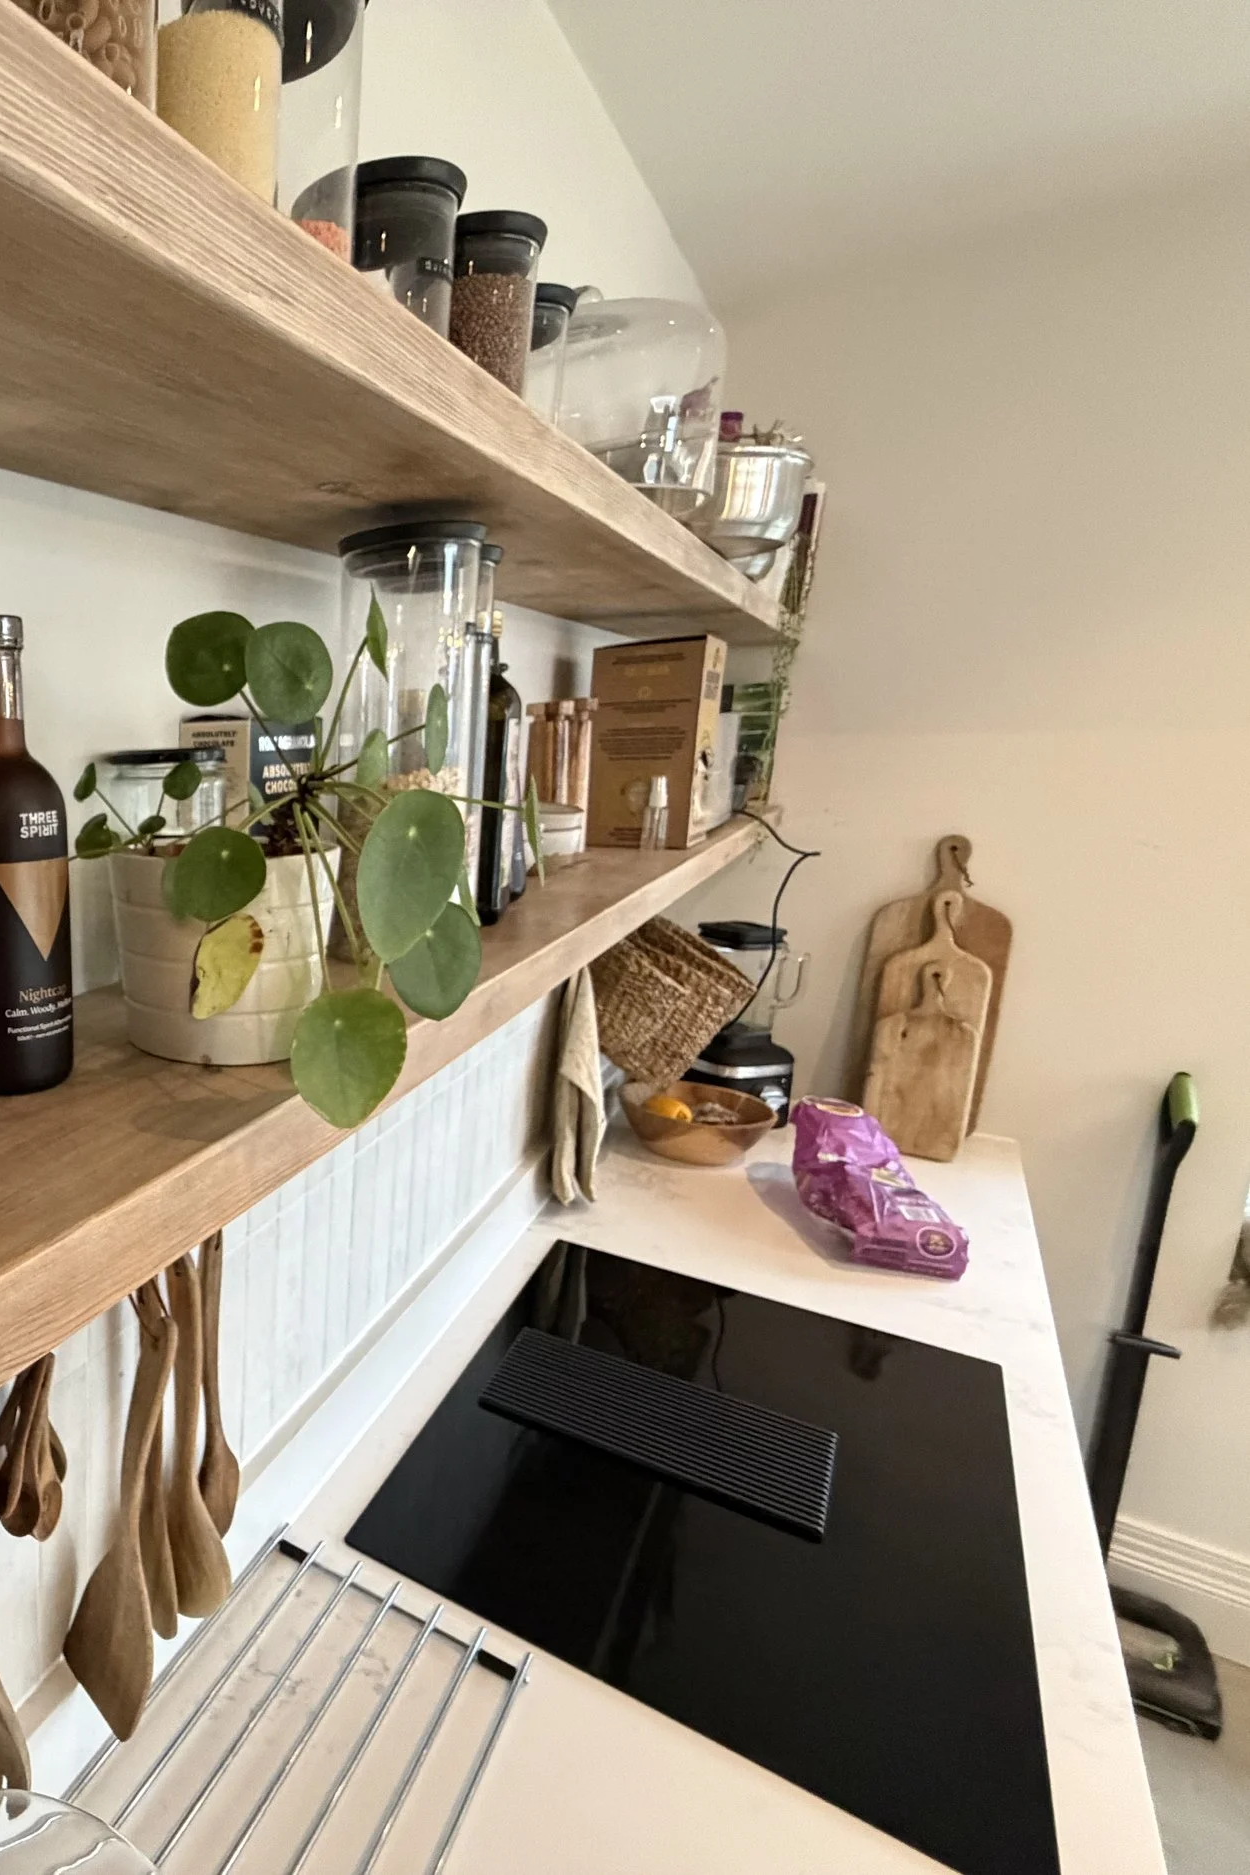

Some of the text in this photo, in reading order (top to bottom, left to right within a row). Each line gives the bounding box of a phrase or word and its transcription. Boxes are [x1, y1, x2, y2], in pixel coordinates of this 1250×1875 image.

[19, 810, 58, 826] THREE
[20, 823, 58, 839] SPIRIT
[5, 1008, 30, 1018] Calm.
